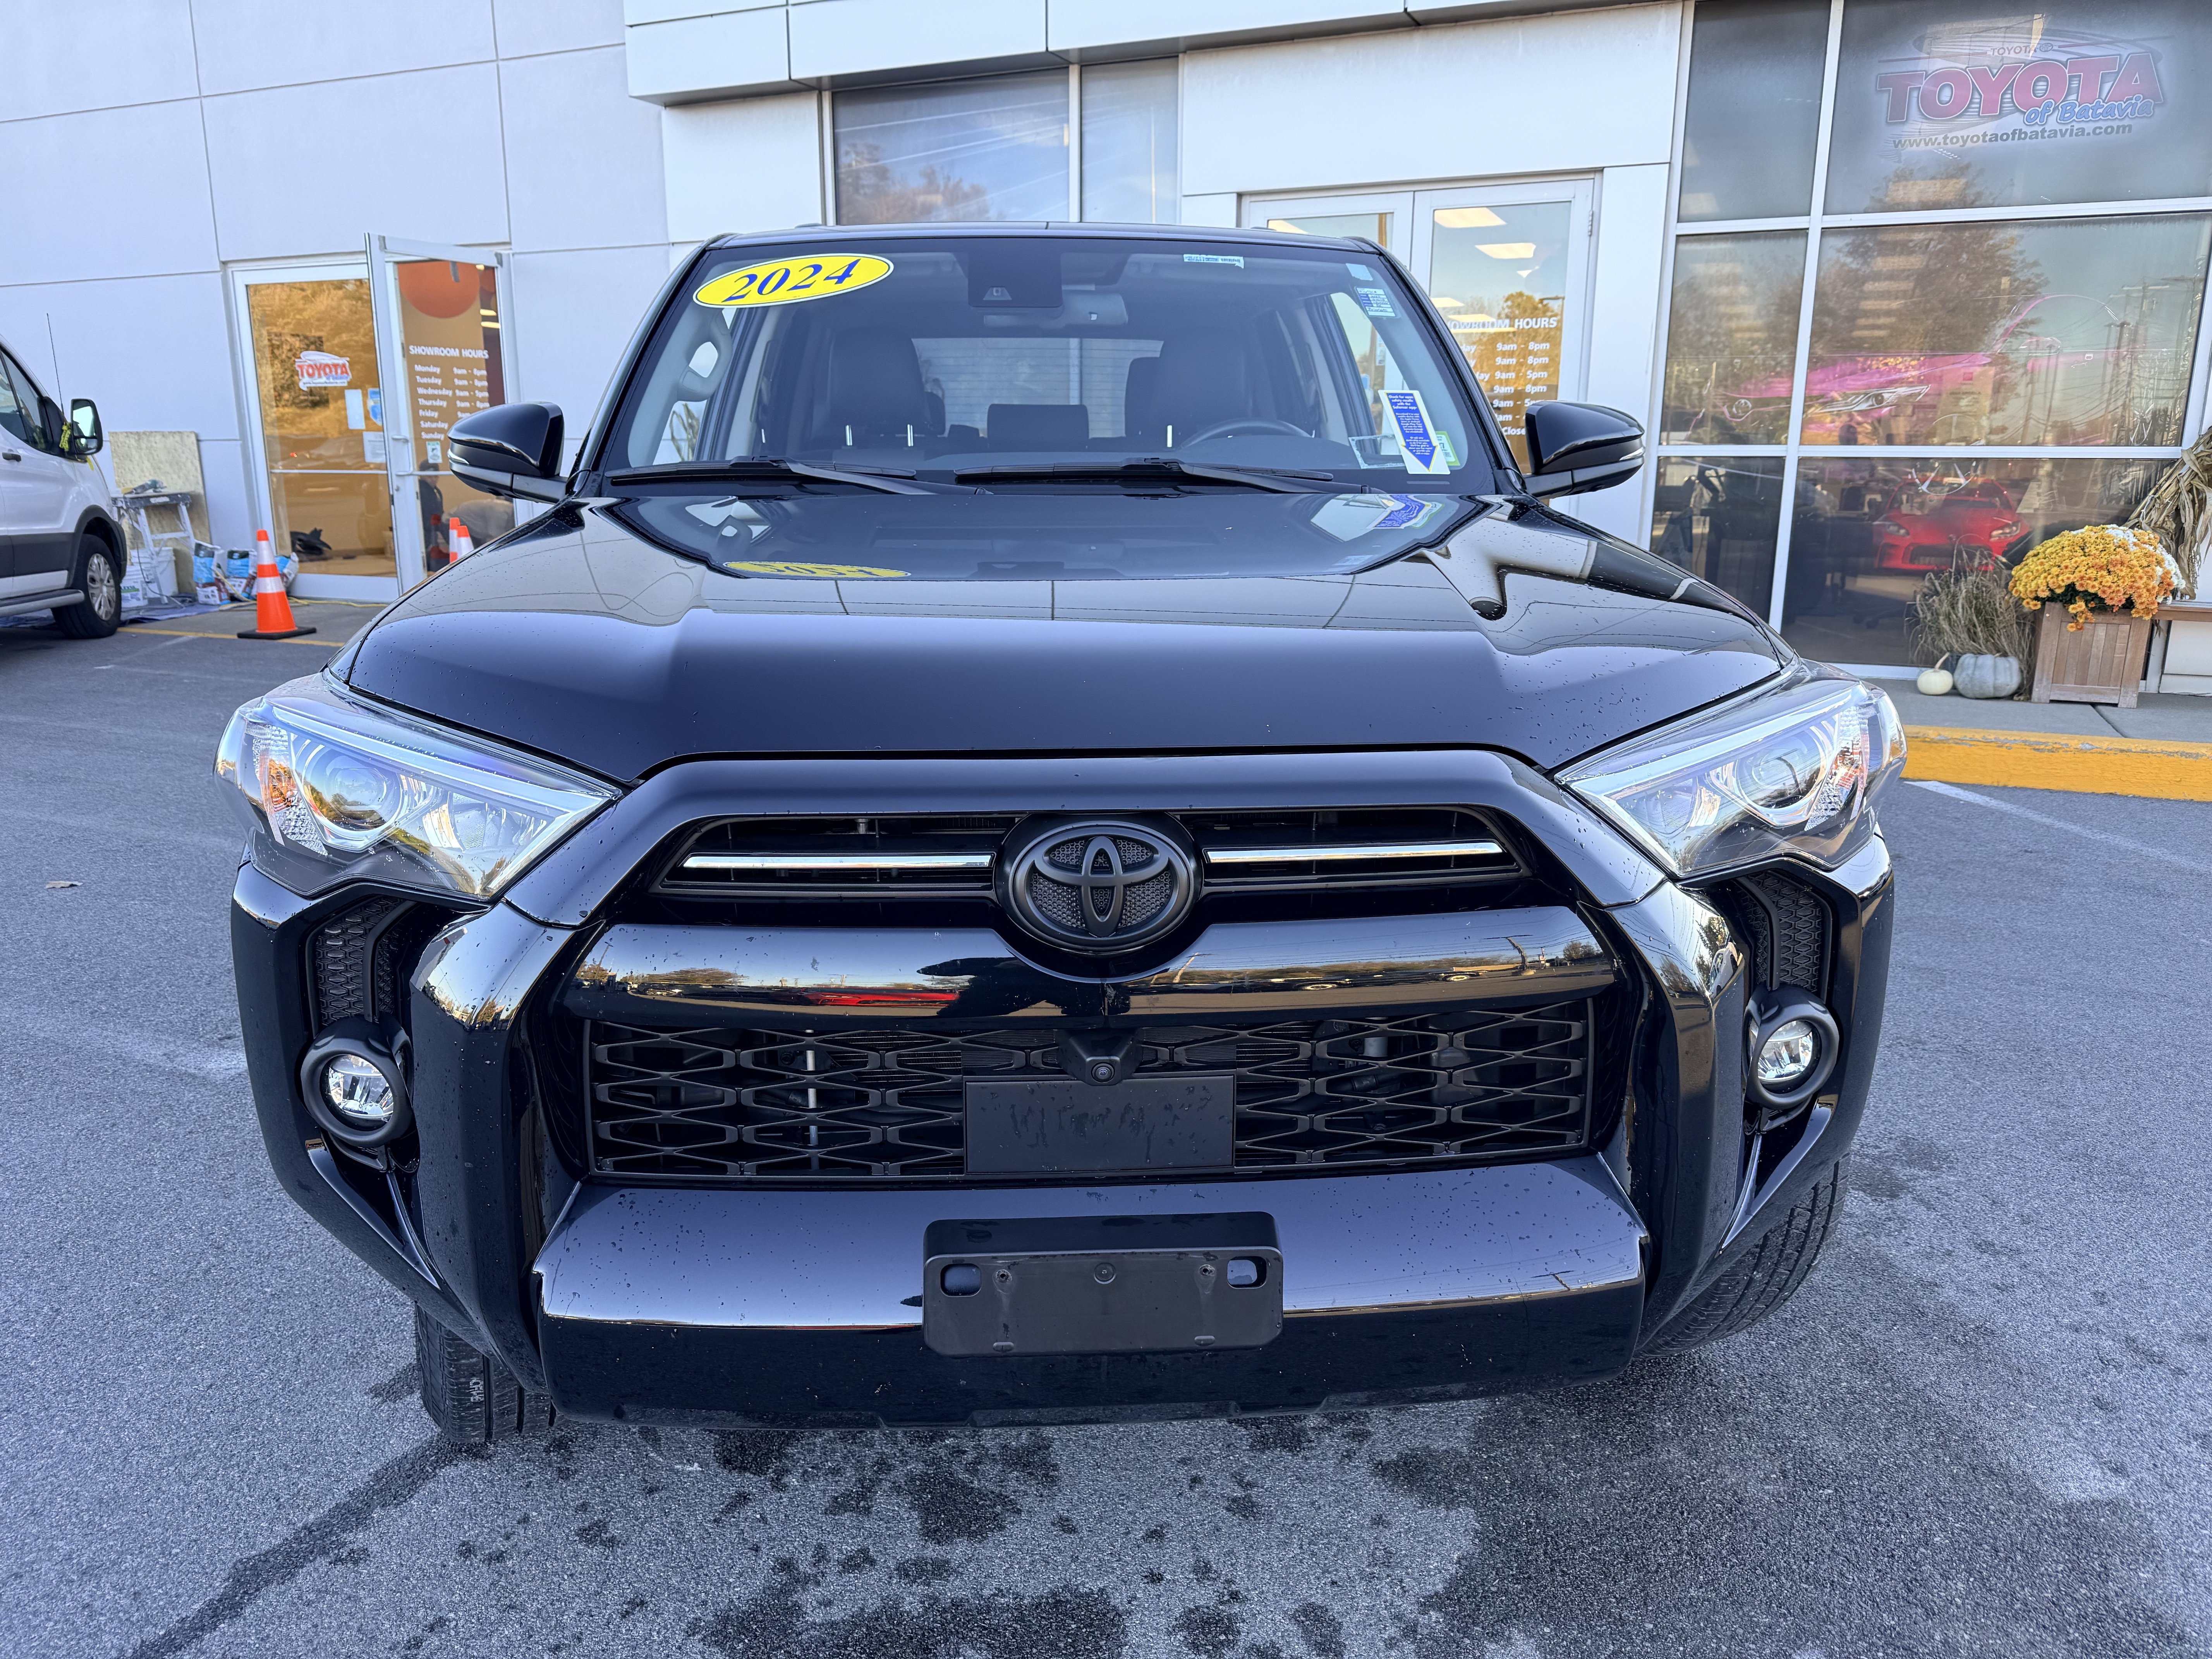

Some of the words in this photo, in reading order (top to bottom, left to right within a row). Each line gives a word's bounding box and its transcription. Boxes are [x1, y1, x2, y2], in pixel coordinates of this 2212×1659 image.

[1990, 44, 2037, 56] TOYOTA
[1877, 53, 2163, 122] TOYOTA
[2024, 101, 2052, 125] of
[2057, 94, 2154, 122] Batavia
[1893, 122, 2133, 149] www.toyotaofbatavia.com
[721, 258, 862, 303] 2024
[1514, 317, 1557, 329] HOURS
[409, 345, 460, 357] SHOWROOM
[462, 349, 489, 359] HOURS
[1496, 342, 1517, 351] 9am
[1528, 341, 1550, 352] 8pm
[1495, 356, 1516, 365] 9am
[1527, 356, 1549, 365] 8pm
[297, 363, 349, 378] TOYOTA
[1495, 371, 1515, 380] 9am
[1527, 370, 1548, 380] 5pm
[1493, 385, 1514, 393] 9am
[1525, 384, 1547, 394] 8pm
[1492, 399, 1514, 407] 9am
[1502, 426, 1526, 435] Close
